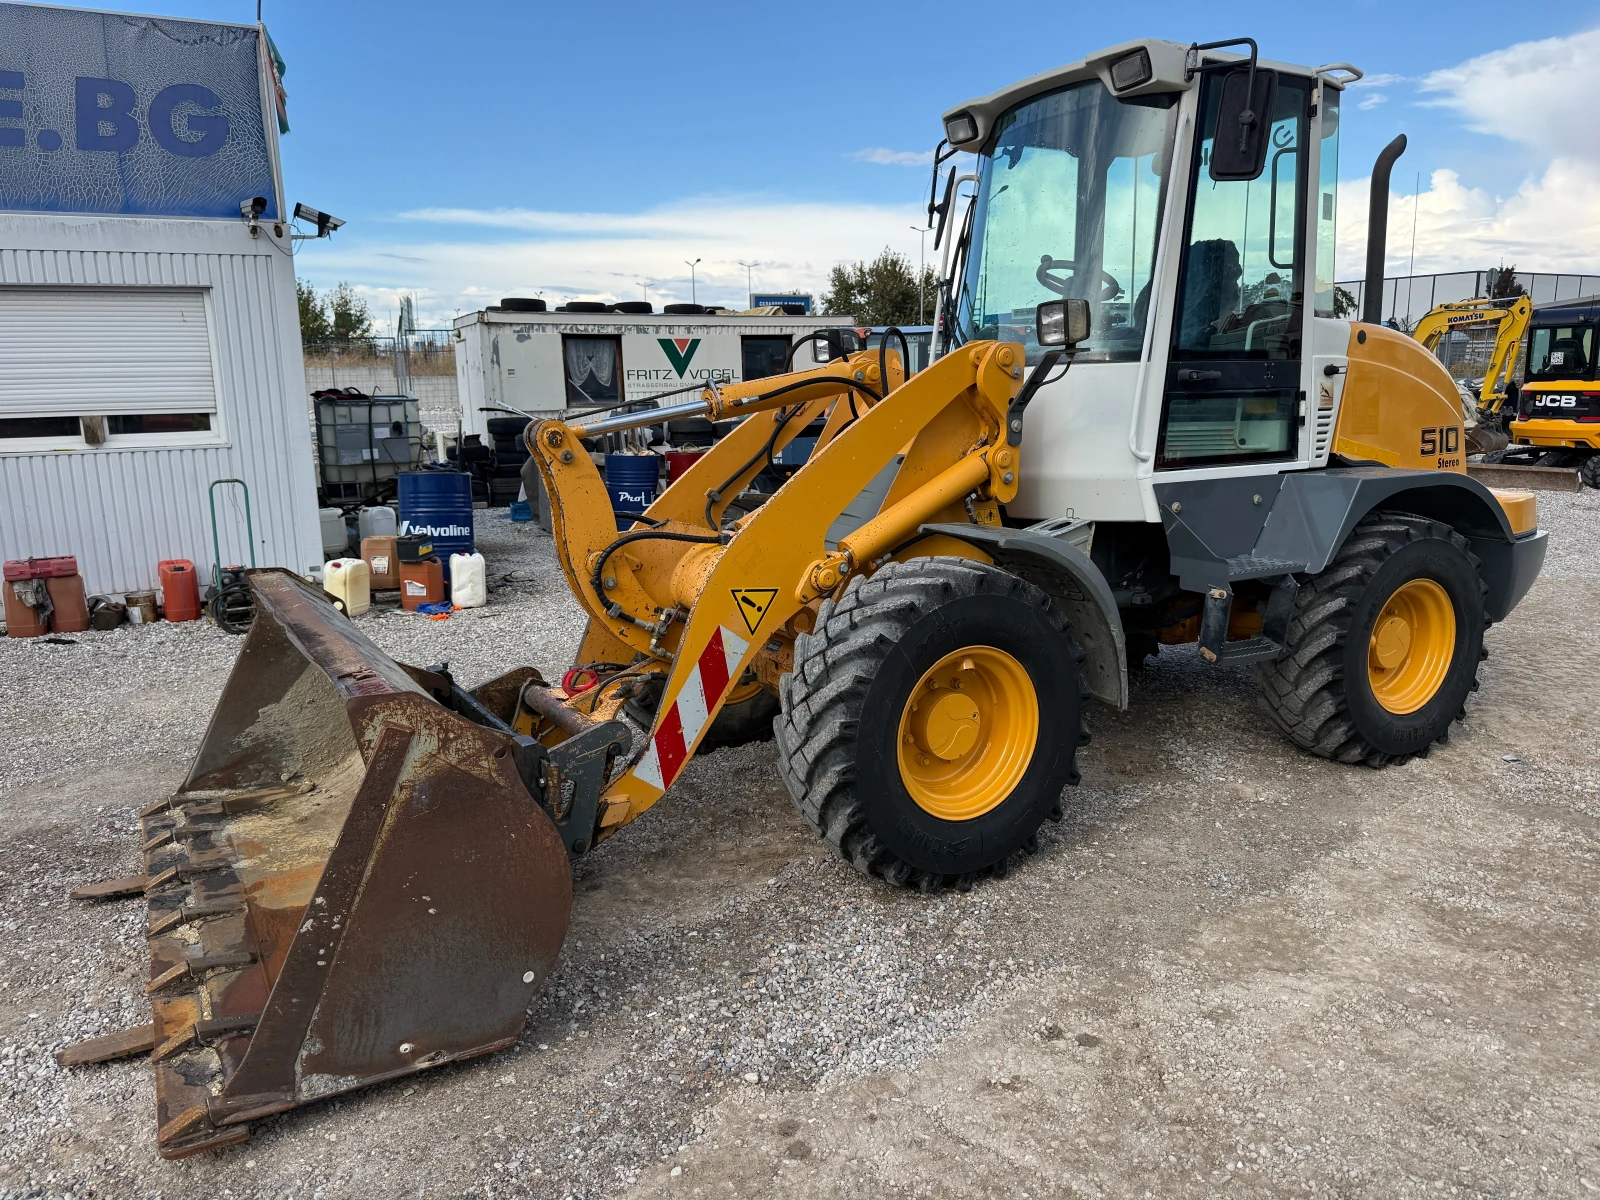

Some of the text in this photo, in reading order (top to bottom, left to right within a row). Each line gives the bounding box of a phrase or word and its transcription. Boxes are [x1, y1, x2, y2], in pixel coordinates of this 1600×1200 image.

[1447, 312, 1484, 323] KOMATSU
[894, 335, 925, 343] HACHI
[626, 368, 741, 381] FRITZ VOGEL
[1535, 394, 1577, 408] JCB
[1420, 425, 1458, 457] 510
[1437, 457, 1460, 469] Stereo
[409, 524, 471, 537] Valvoline
